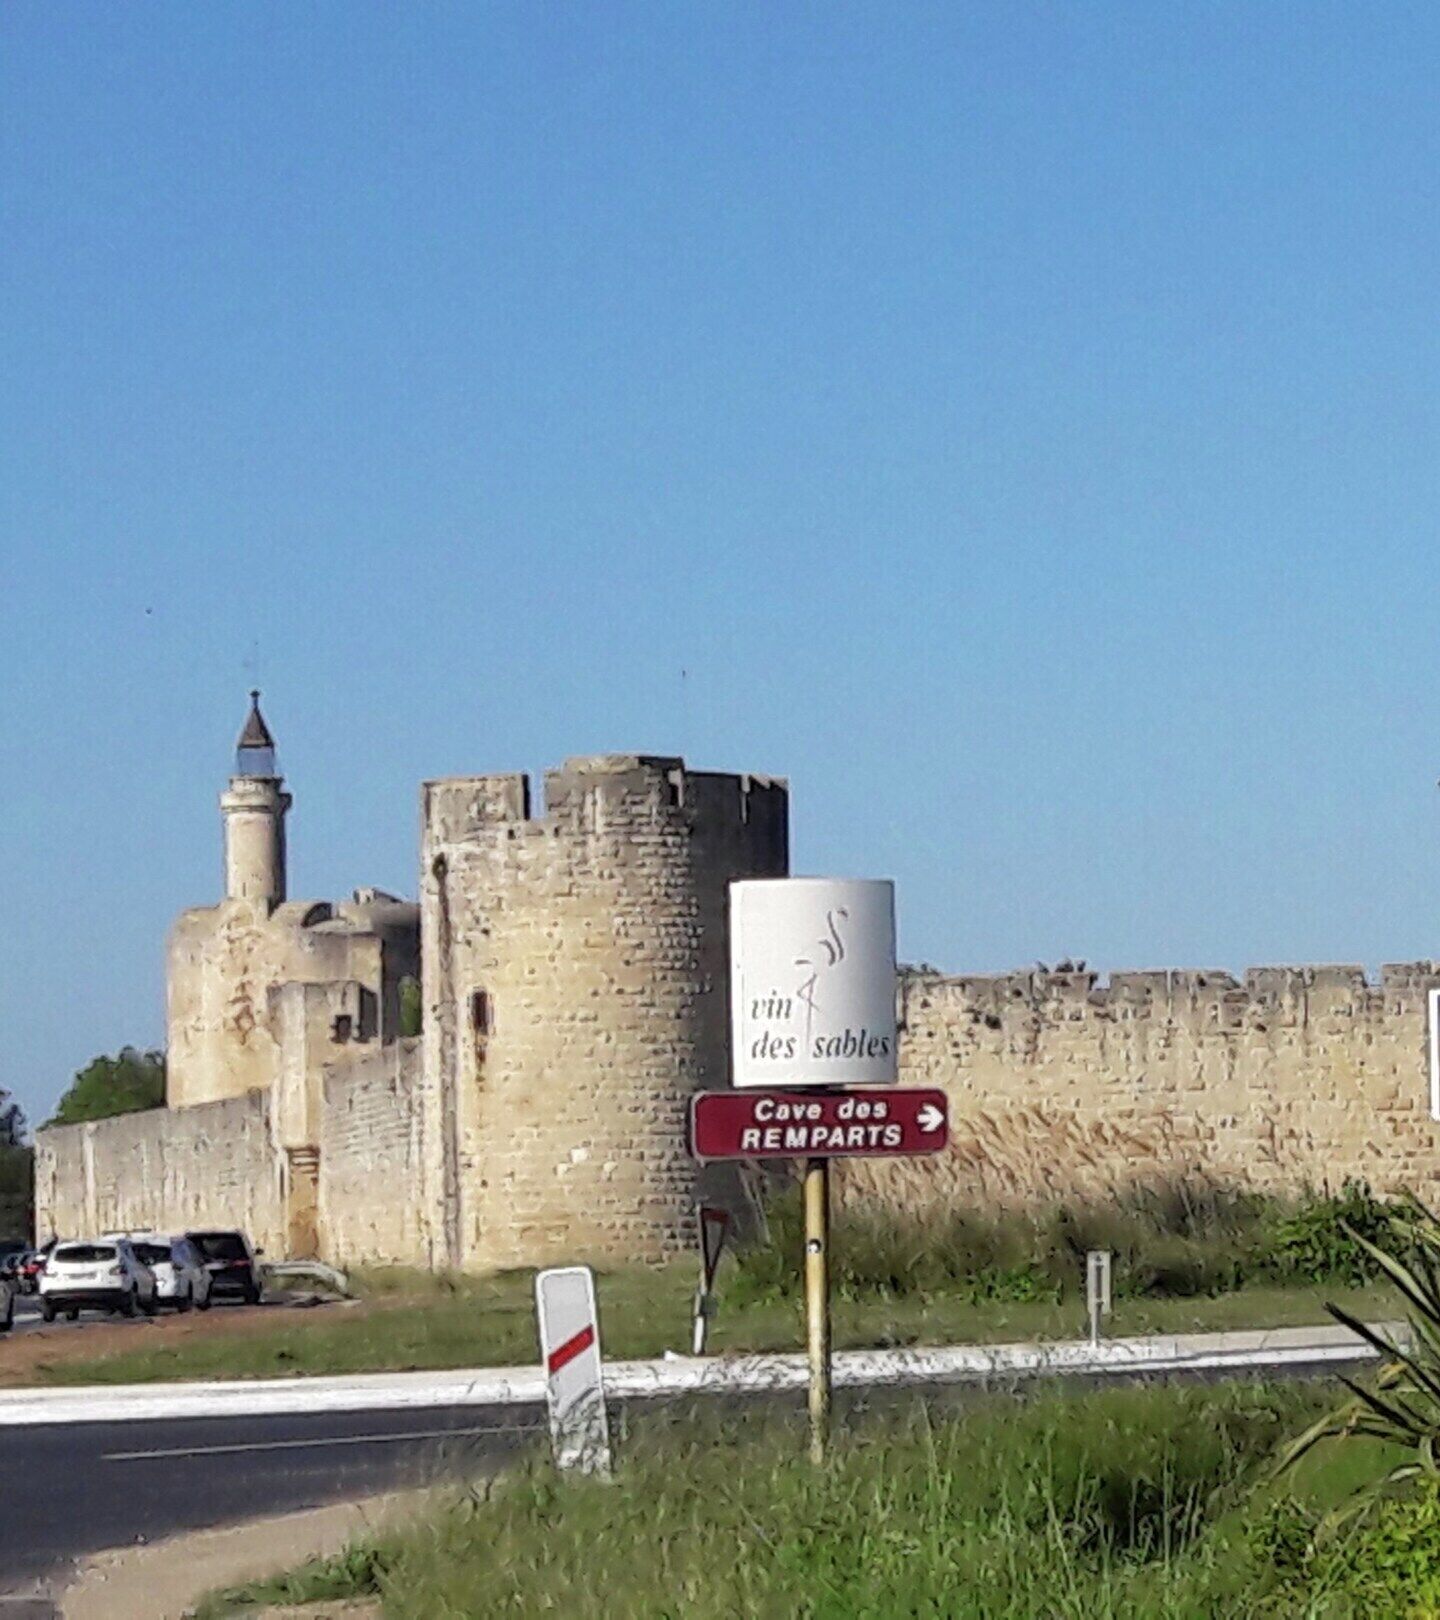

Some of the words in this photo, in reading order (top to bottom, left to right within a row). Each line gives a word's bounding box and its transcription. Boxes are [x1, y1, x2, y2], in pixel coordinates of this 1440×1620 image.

[751, 989, 792, 1020] vin
[751, 1030, 795, 1060] des
[812, 1029, 891, 1059] sables
[754, 1099, 822, 1121] Cave
[838, 1098, 887, 1119] des
[741, 1124, 902, 1150] REMPARTS
